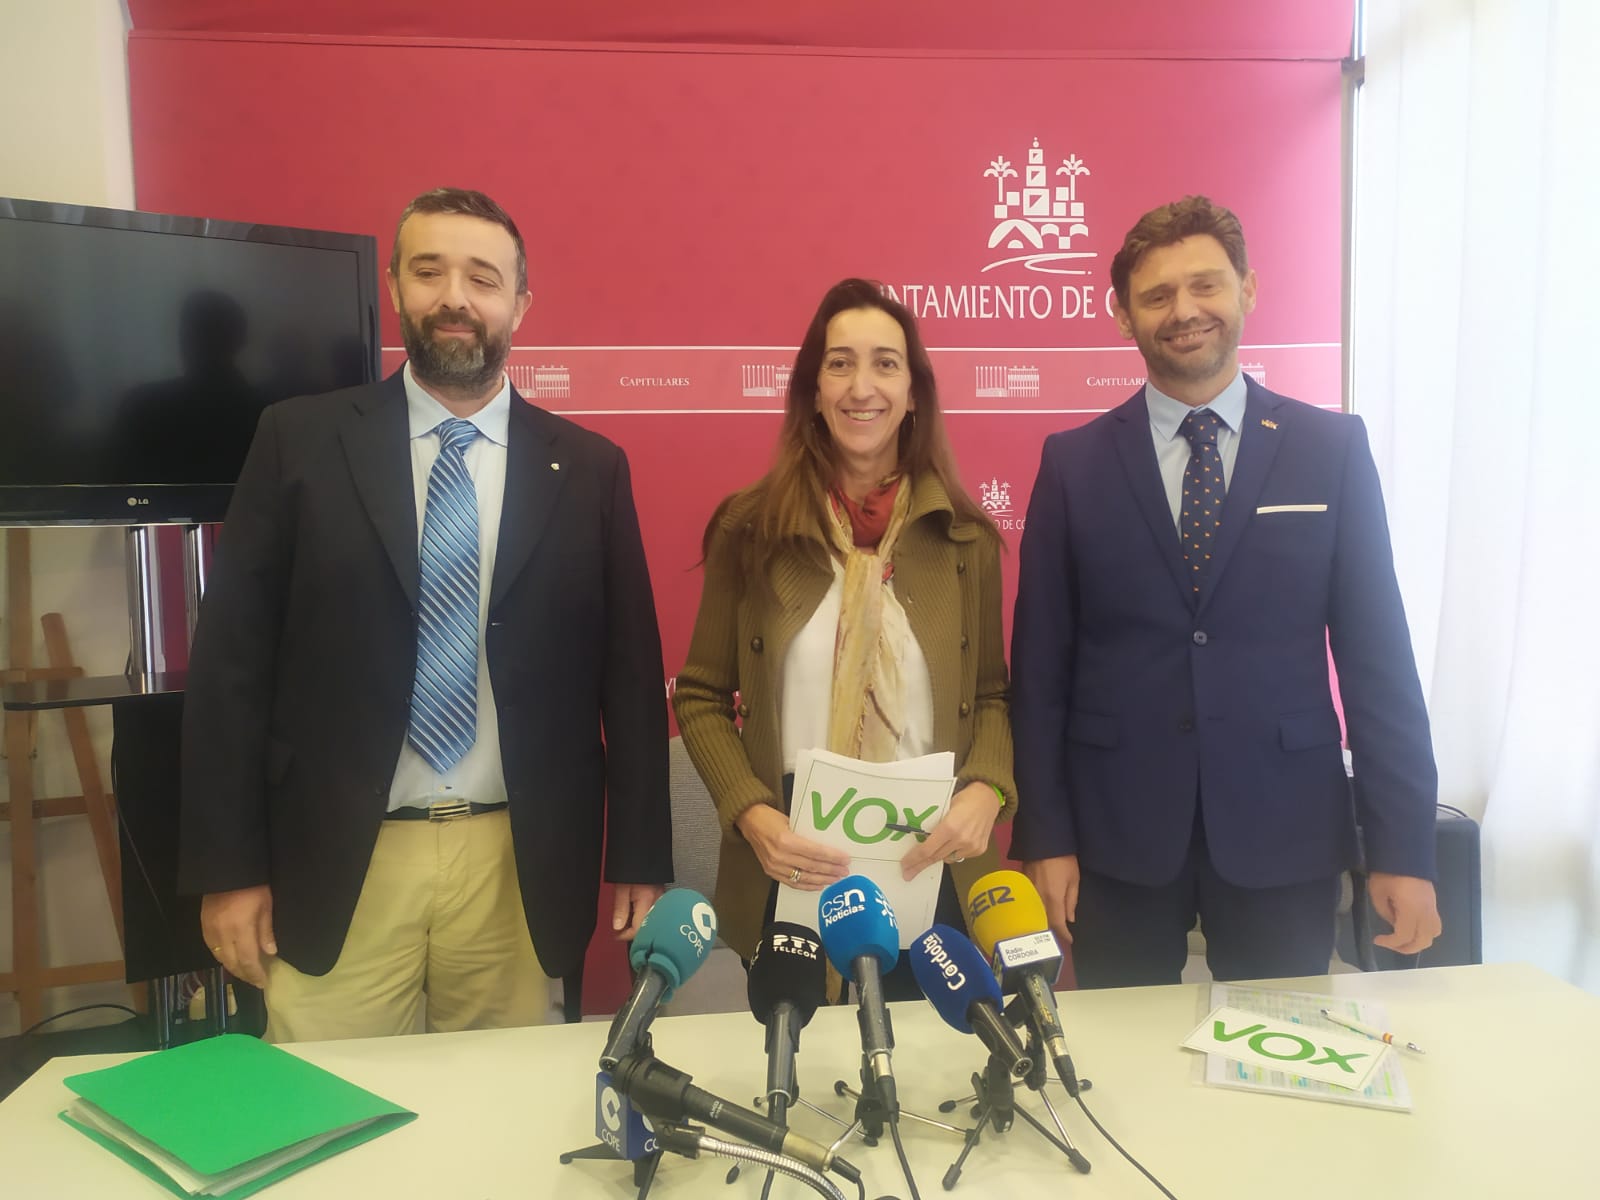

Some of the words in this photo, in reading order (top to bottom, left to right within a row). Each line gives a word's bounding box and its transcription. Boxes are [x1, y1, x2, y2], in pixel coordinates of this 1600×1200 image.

[879, 284, 1052, 319] NTAMIENTO
[1061, 285, 1097, 319] DE
[619, 376, 690, 387] CAPITULARES
[1086, 376, 1148, 386] CAPITULARE
[1002, 519, 1014, 530] DE
[811, 787, 939, 843] VOX
[825, 904, 865, 928] Noticias
[679, 924, 704, 958] COPE
[773, 934, 819, 953] PTV
[773, 946, 817, 960] TELECOM
[1213, 1020, 1369, 1073] VOX
[601, 1128, 621, 1152] COPE
